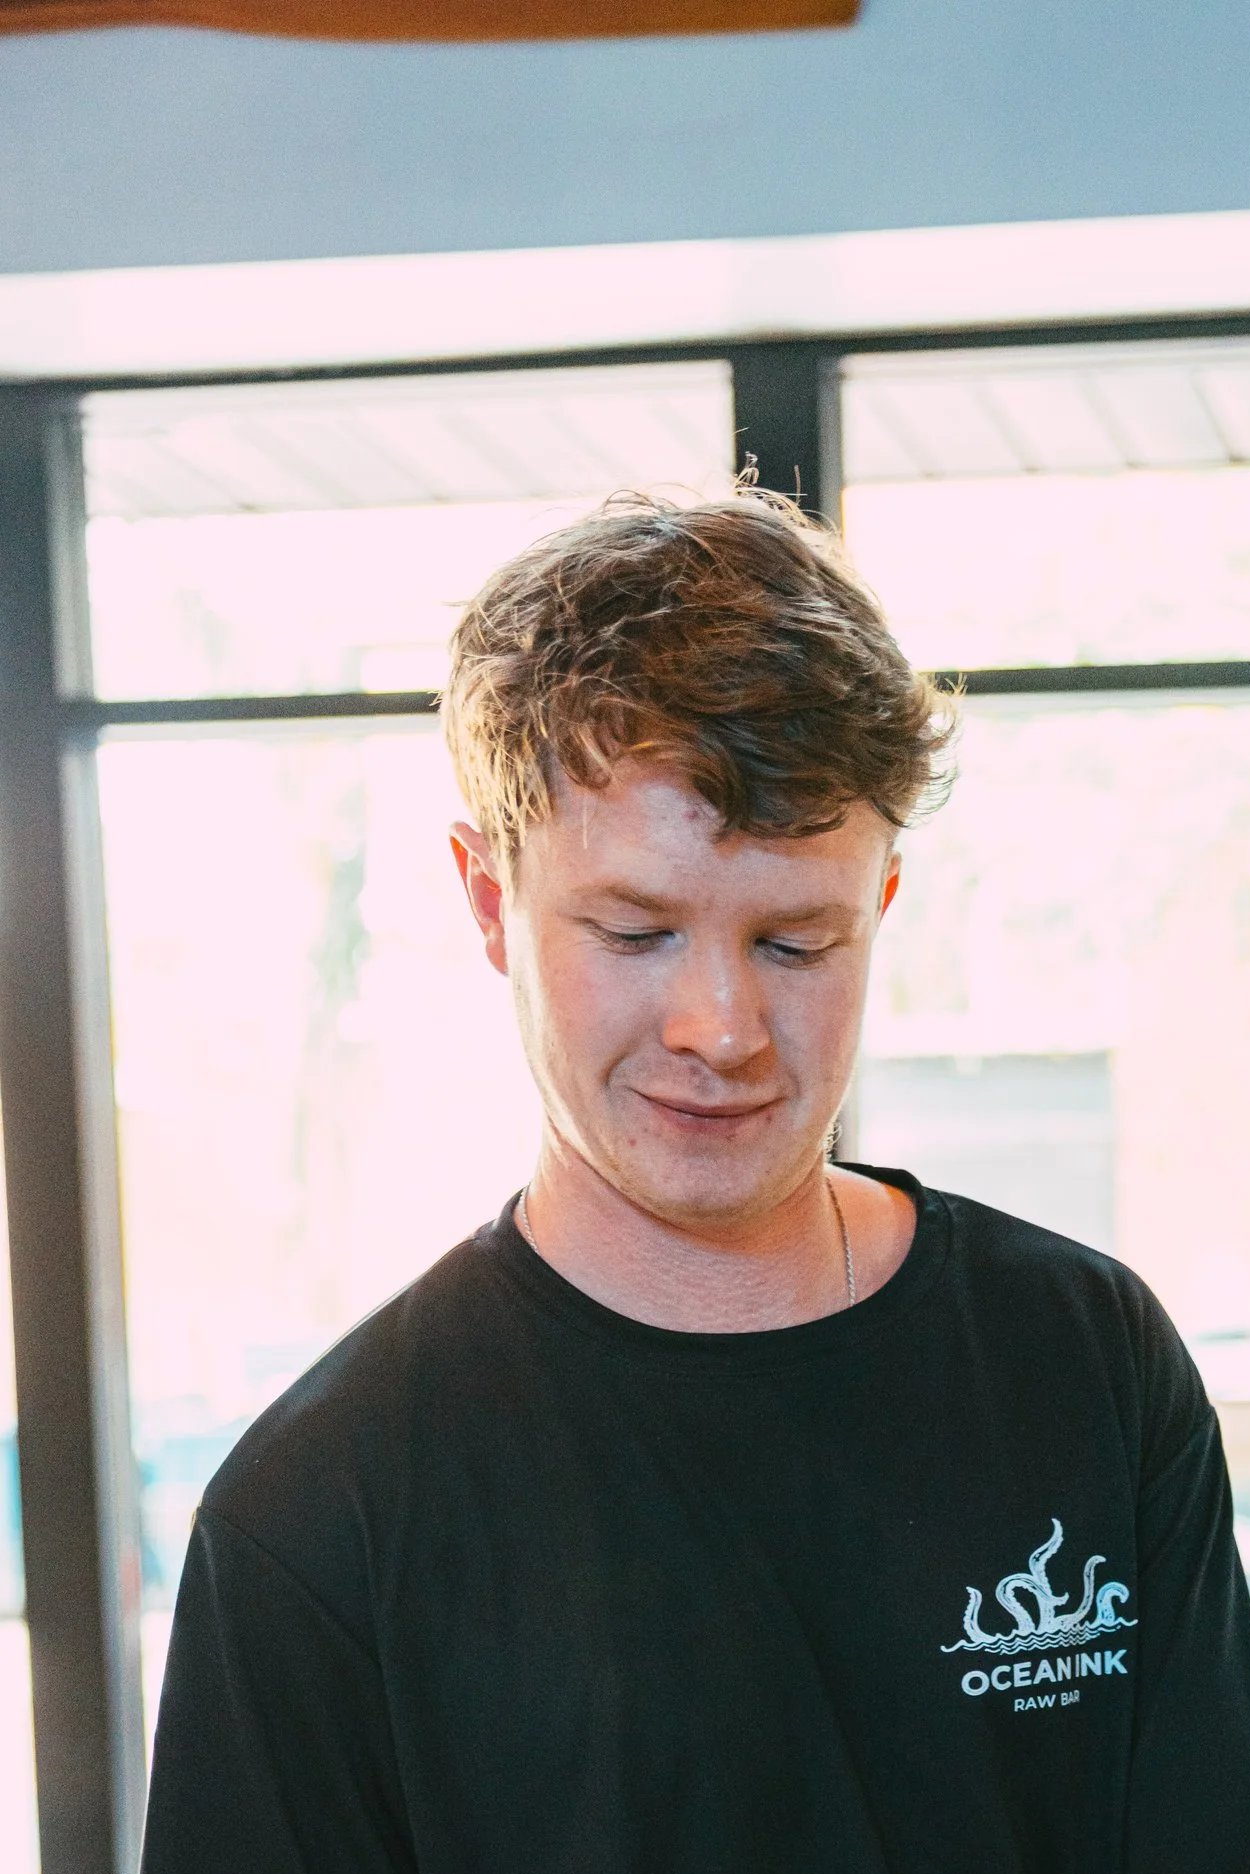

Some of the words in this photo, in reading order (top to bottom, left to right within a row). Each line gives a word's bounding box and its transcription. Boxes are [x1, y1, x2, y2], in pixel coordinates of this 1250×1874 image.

[961, 1656, 1072, 1696] OCEAN
[1075, 1649, 1128, 1678] INK
[1014, 1694, 1056, 1712] RAW
[1061, 1690, 1080, 1707] BAR
